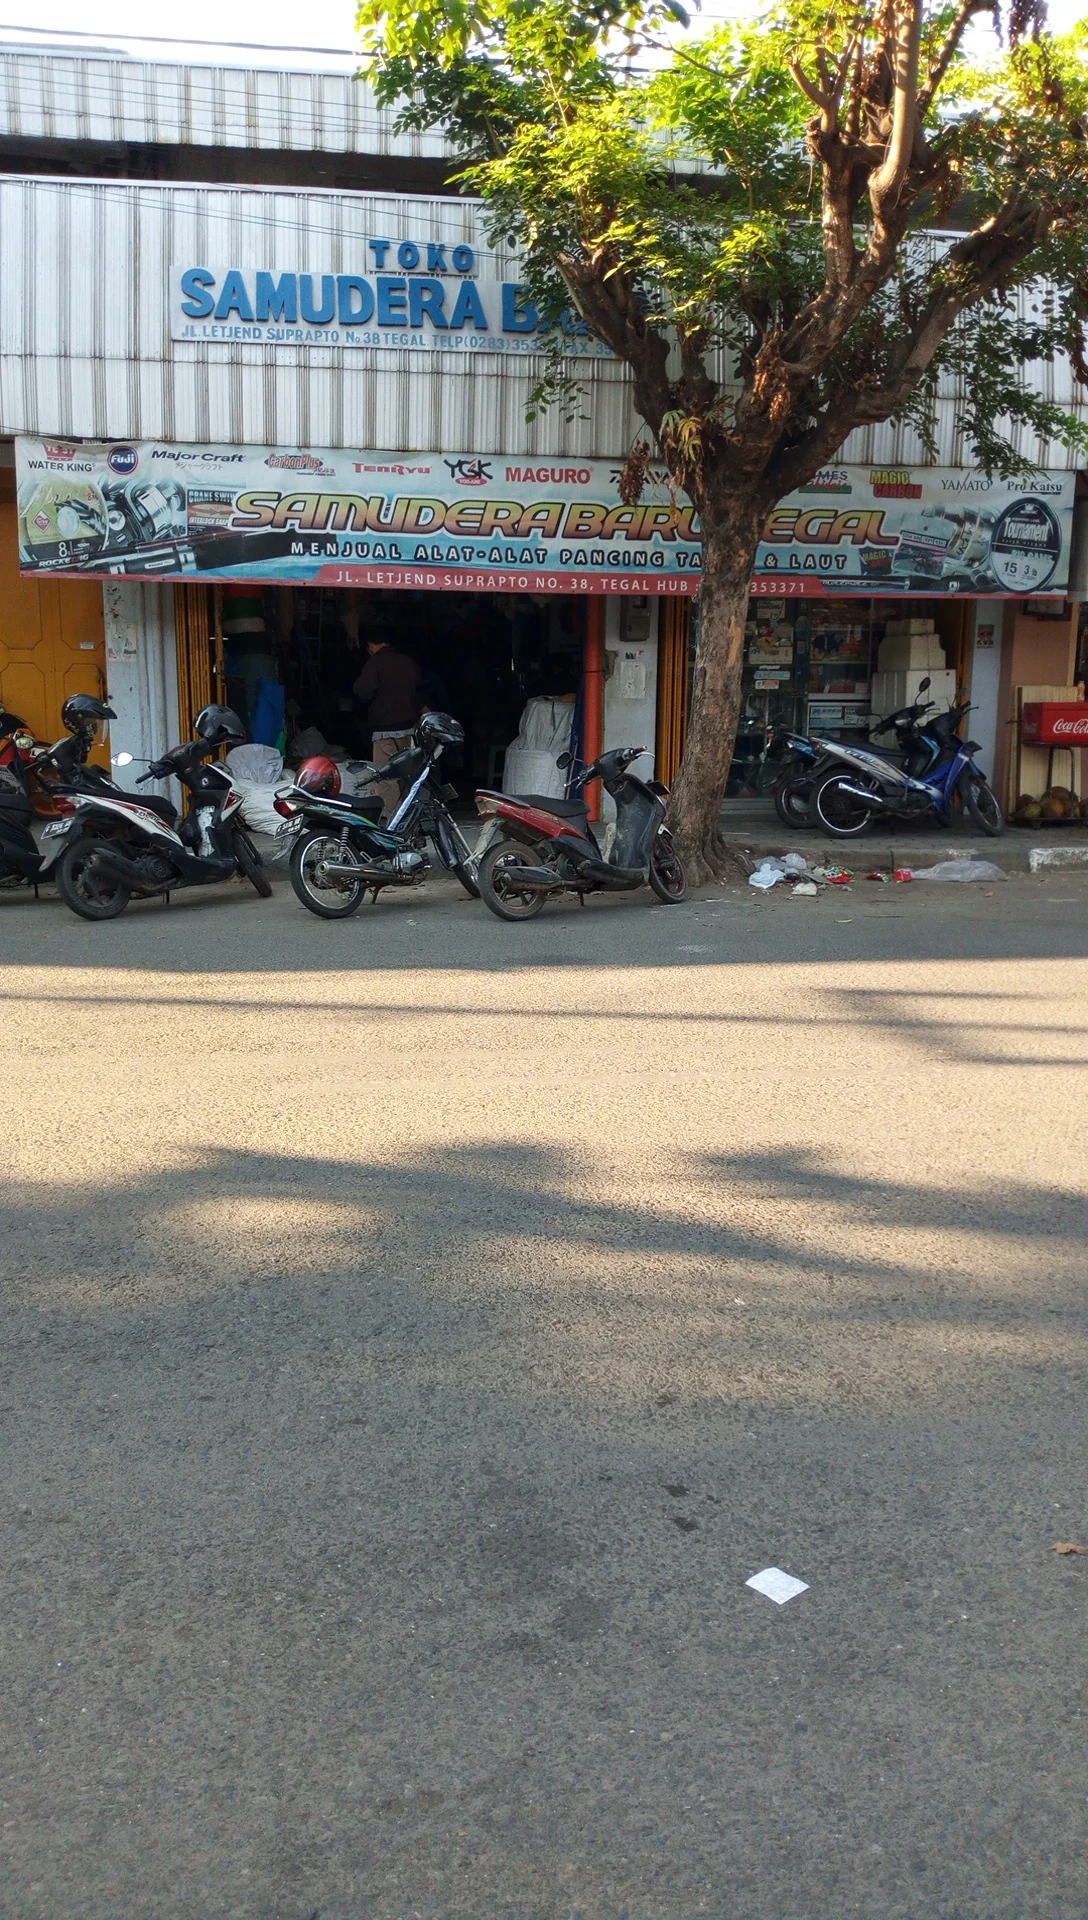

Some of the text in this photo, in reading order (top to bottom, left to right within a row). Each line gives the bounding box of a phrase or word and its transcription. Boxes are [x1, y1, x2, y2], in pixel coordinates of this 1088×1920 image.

[368, 239, 474, 273] TOKO
[180, 267, 488, 330] SAMUDERA
[202, 325, 262, 340] LETJEND
[267, 328, 339, 342] SUPRAPTO
[152, 450, 244, 463] Major Craft
[267, 452, 321, 470] CarbonPlus
[28, 460, 92, 472] WATER KING
[505, 466, 591, 484] MAGURO
[869, 470, 911, 485] MAGIC
[873, 484, 923, 499] CARBON
[941, 479, 990, 491] YAMATO
[1006, 480, 1062, 492] Pro Katsu
[231, 490, 563, 539] SAMUDERA
[761, 508, 900, 546] EGAL
[1003, 517, 1050, 542] Tournament
[58, 542, 68, 557] 8
[291, 541, 401, 559] MENJUAL
[416, 544, 547, 563] ALAT-ALAT
[561, 549, 664, 568] PANCING
[764, 554, 778, 569] &
[790, 554, 847, 569] LAUT
[1004, 561, 1018, 574] 15
[1024, 564, 1030, 575] 3
[336, 570, 359, 582] JL.
[367, 571, 436, 585] LETJEND
[444, 574, 528, 589] SUPRAPTO
[536, 576, 563, 589] NO.
[570, 577, 594, 591] 38,
[601, 578, 650, 591] TEGAL
[657, 580, 688, 592] HUB
